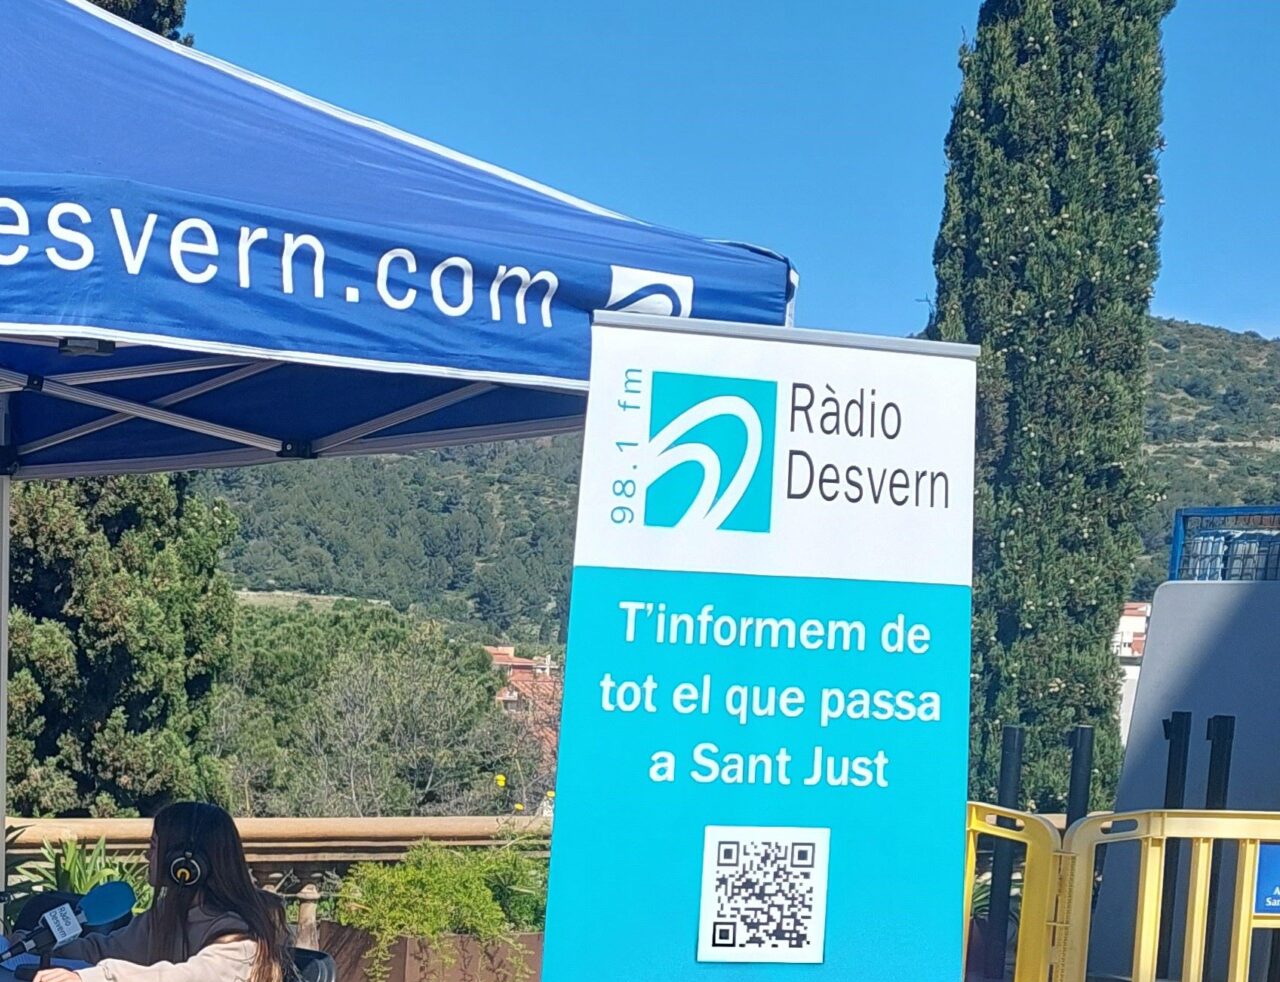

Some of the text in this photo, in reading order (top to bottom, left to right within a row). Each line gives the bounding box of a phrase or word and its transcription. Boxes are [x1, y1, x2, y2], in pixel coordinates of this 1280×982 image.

[789, 382, 902, 440] Ràdio
[610, 368, 642, 525] 98.1 fm
[786, 449, 950, 509] Desvern
[880, 613, 932, 654] de
[599, 672, 941, 728] tot el que passa
[648, 742, 890, 788] a Sant Just
